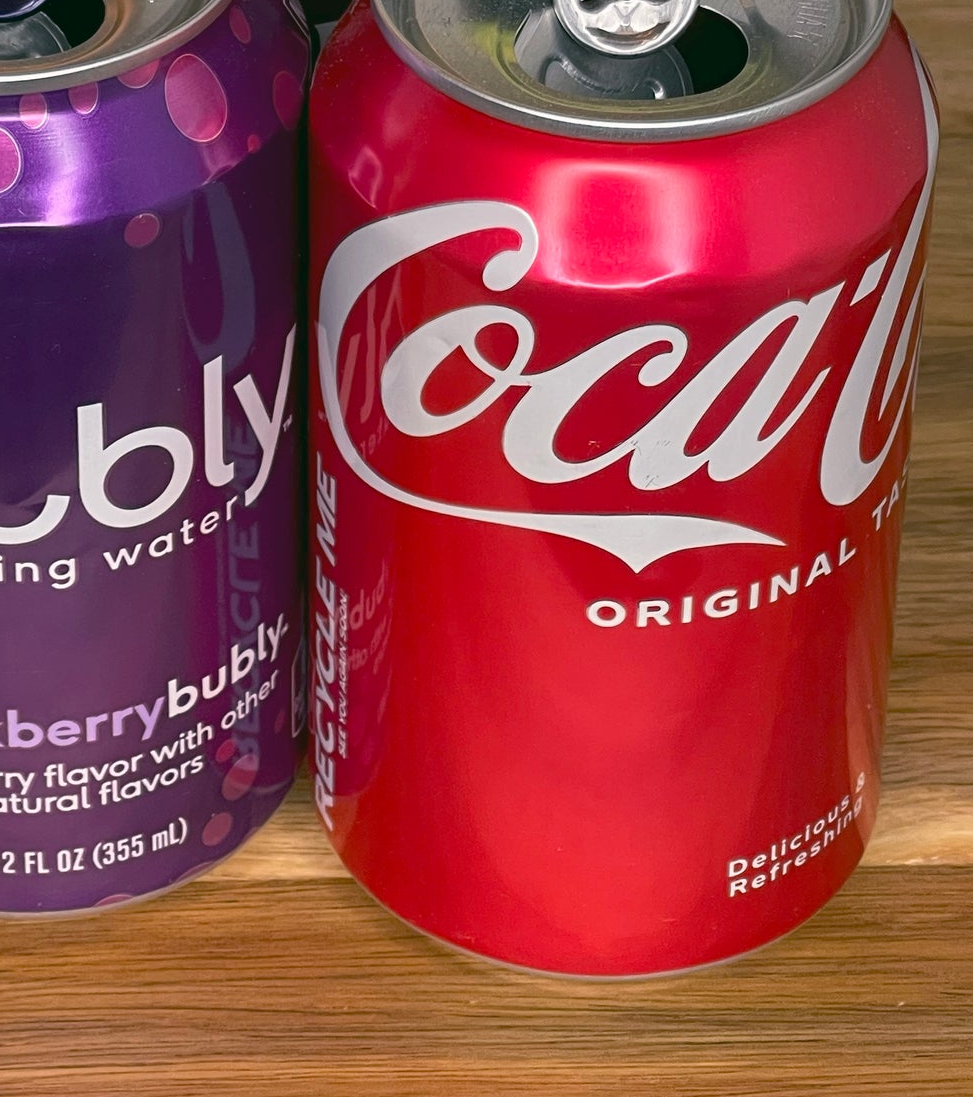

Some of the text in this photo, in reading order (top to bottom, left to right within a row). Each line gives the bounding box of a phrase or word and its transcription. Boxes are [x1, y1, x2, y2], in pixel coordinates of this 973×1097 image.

[103, 495, 240, 571] water
[586, 538, 857, 628] ORIGINAL
[315, 451, 336, 832] RECYCLE ME
[338, 641, 347, 694] AGAIN
[44, 754, 144, 788] flavor
[150, 722, 213, 763] with
[221, 670, 280, 730] other
[338, 691, 347, 725] YOU
[338, 725, 347, 759] SEE
[98, 755, 204, 805] flavors
[24, 851, 50, 874] FL
[57, 847, 85, 873] OZ
[92, 833, 144, 870] (355
[151, 816, 188, 852] mL)
[728, 795, 850, 878] Delicious
[729, 796, 863, 898] Refreshing
